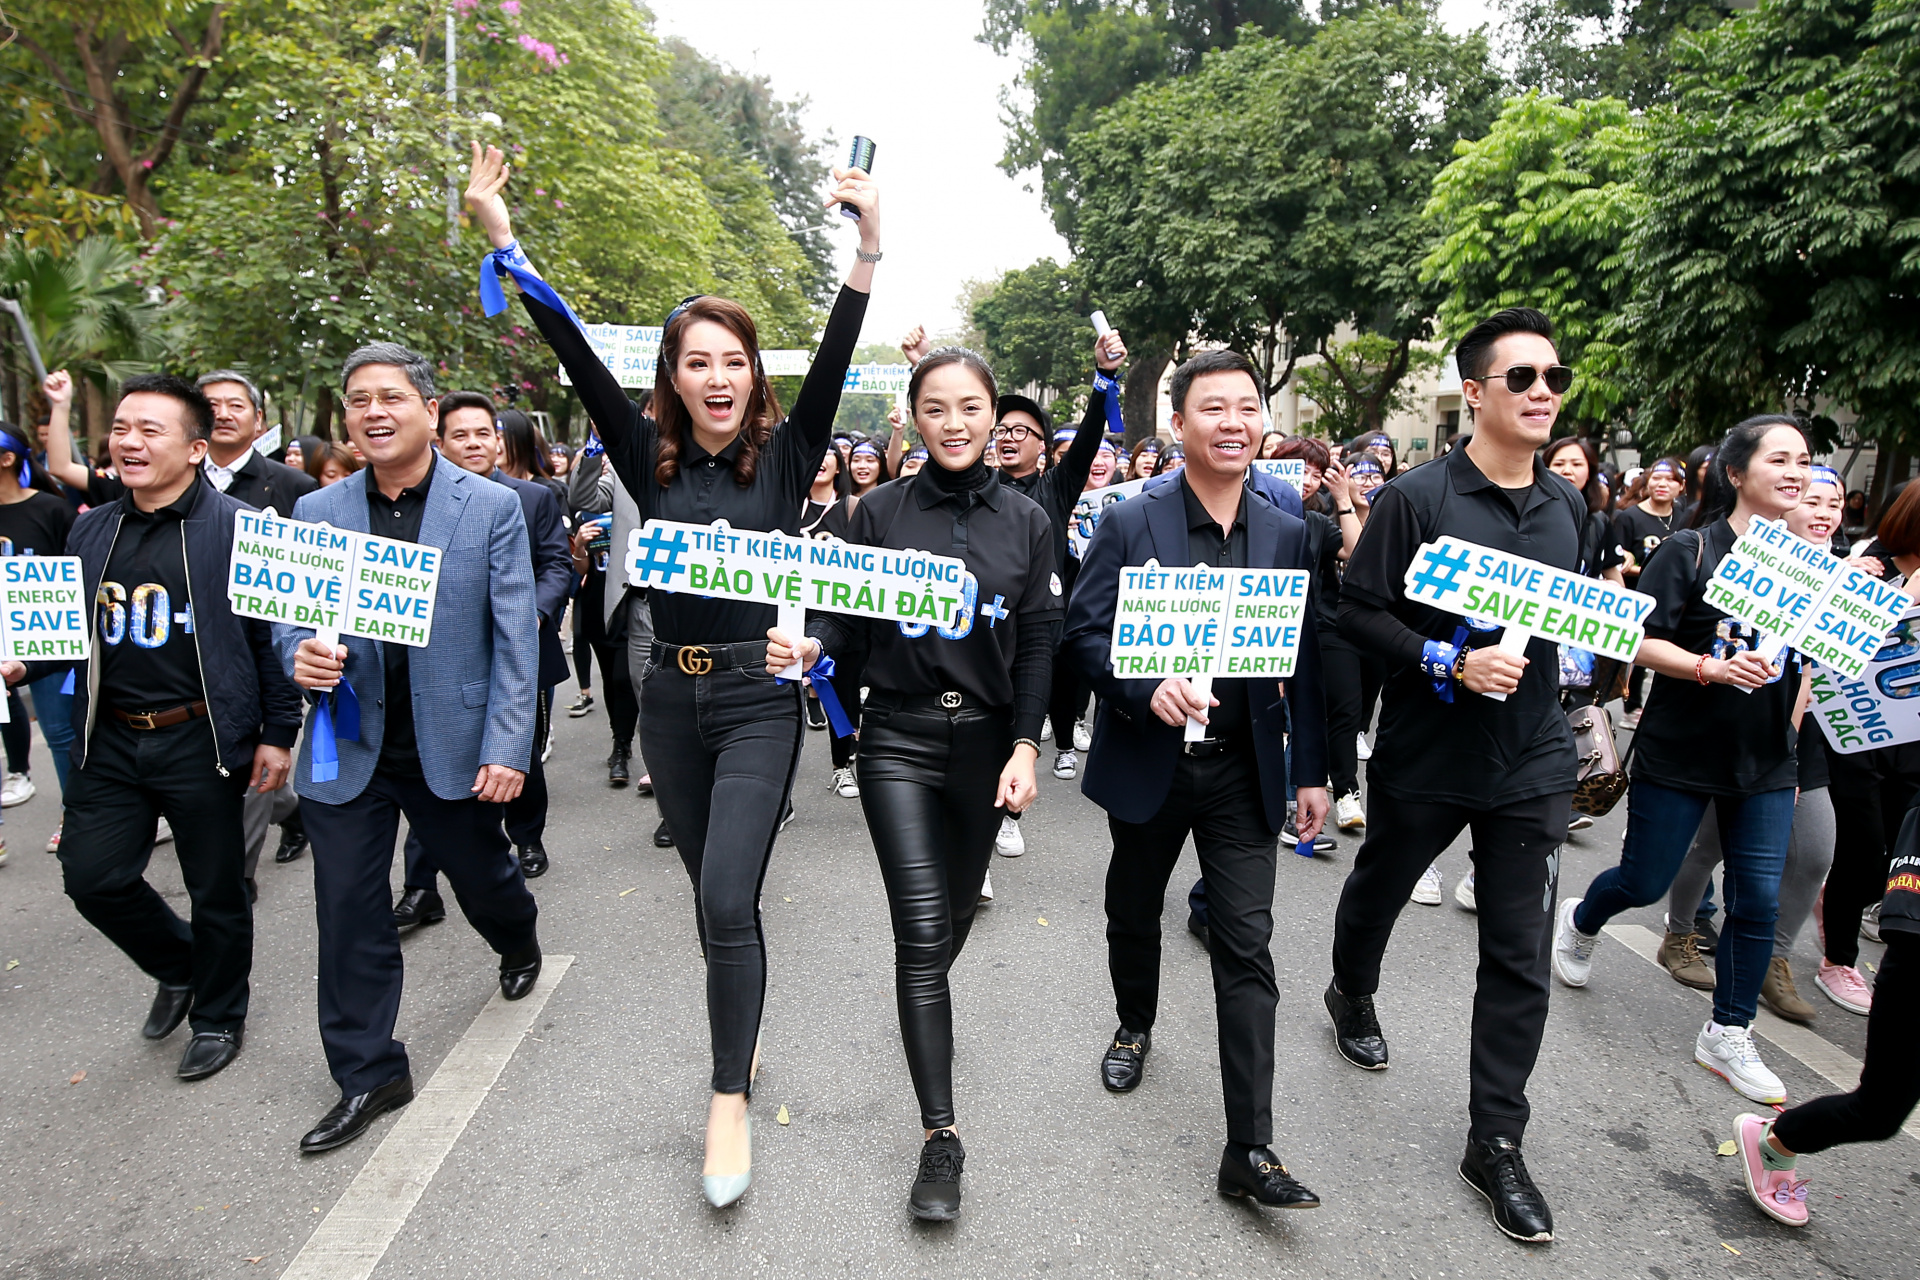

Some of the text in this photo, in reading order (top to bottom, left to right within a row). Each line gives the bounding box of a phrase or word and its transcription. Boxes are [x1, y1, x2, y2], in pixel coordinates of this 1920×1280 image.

[625, 329, 662, 342] SAVE
[862, 376, 905, 394] BẢO VỆ
[883, 366, 905, 377] KIỆM
[1266, 463, 1302, 475] SAVE
[241, 513, 347, 551] TIẾT KIỆM
[1751, 519, 1837, 575] TIẾT KIỆM
[238, 540, 344, 572] NĂNG LƯỢNG
[363, 541, 435, 573] SAVE
[692, 525, 958, 584] TIẾT KIỆM NĂNG LƯỢNG
[1738, 541, 1824, 592] NĂNG LƯỢNG
[5, 562, 76, 582] SAVE
[234, 559, 342, 608] BẢO VỆ
[360, 568, 431, 592] ENERGY
[1126, 565, 1224, 595] TIẾT KIỆM
[1239, 575, 1305, 597] SAVE
[1475, 554, 1650, 622] SAVE ENERGY
[7, 590, 77, 603] ENERGY
[357, 588, 429, 619] SAVE
[690, 557, 958, 622] BẢO VỆ TRÁI ĐẤT
[1719, 559, 1812, 620] BẢO VỆ
[1842, 572, 1908, 617] SAVE
[10, 610, 81, 631] SAVE
[233, 593, 338, 627] TRÁI ĐẤT
[1123, 597, 1221, 616] NĂNG LƯỢNG
[1235, 604, 1300, 618] ENERGY
[1463, 585, 1639, 656] SAVE EARTH
[1708, 583, 1794, 638] TRÁI ĐẤT
[1830, 594, 1892, 633] ENERGY
[354, 617, 425, 643] EARTH
[1118, 615, 1218, 652] BẢO VỆ
[1231, 626, 1297, 647] SAVE
[1815, 612, 1880, 656] SAVE
[13, 640, 84, 656] EARTH
[1117, 648, 1214, 673] TRÁI ĐẤT
[1800, 635, 1863, 676] EARTH
[1228, 657, 1292, 673] EARTH
[1824, 708, 1864, 748] RÁC
